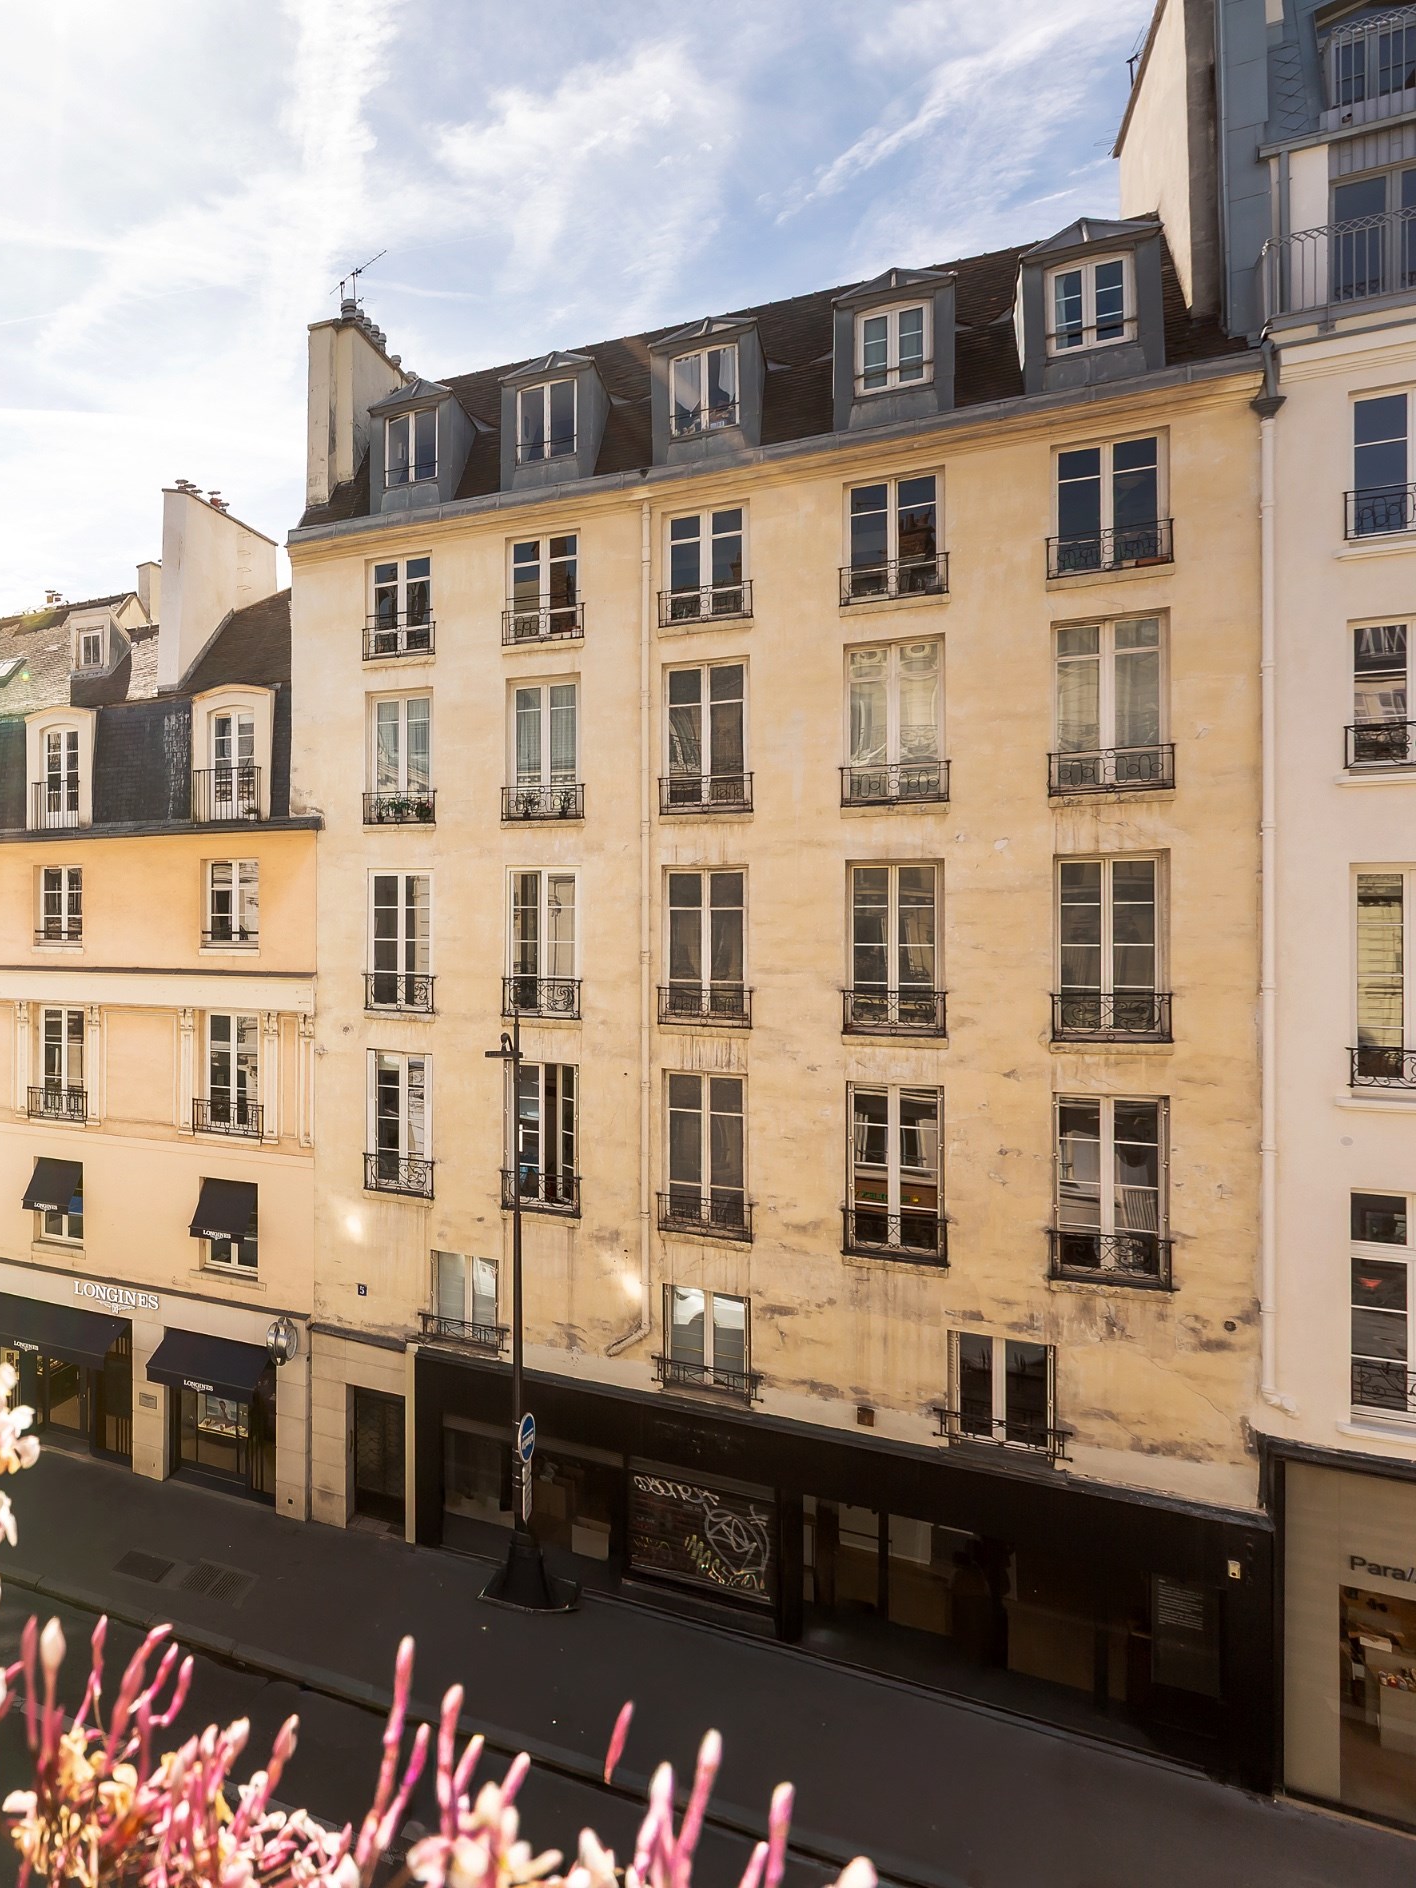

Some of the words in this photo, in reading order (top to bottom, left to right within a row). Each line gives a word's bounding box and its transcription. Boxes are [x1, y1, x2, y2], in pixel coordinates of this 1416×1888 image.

[34, 1202, 58, 1211] LONGINES
[203, 1229, 231, 1239] LONGINES
[73, 1281, 159, 1310] LONGINES
[13, 1340, 39, 1351] LONGINES
[183, 1379, 214, 1392] LONGINES
